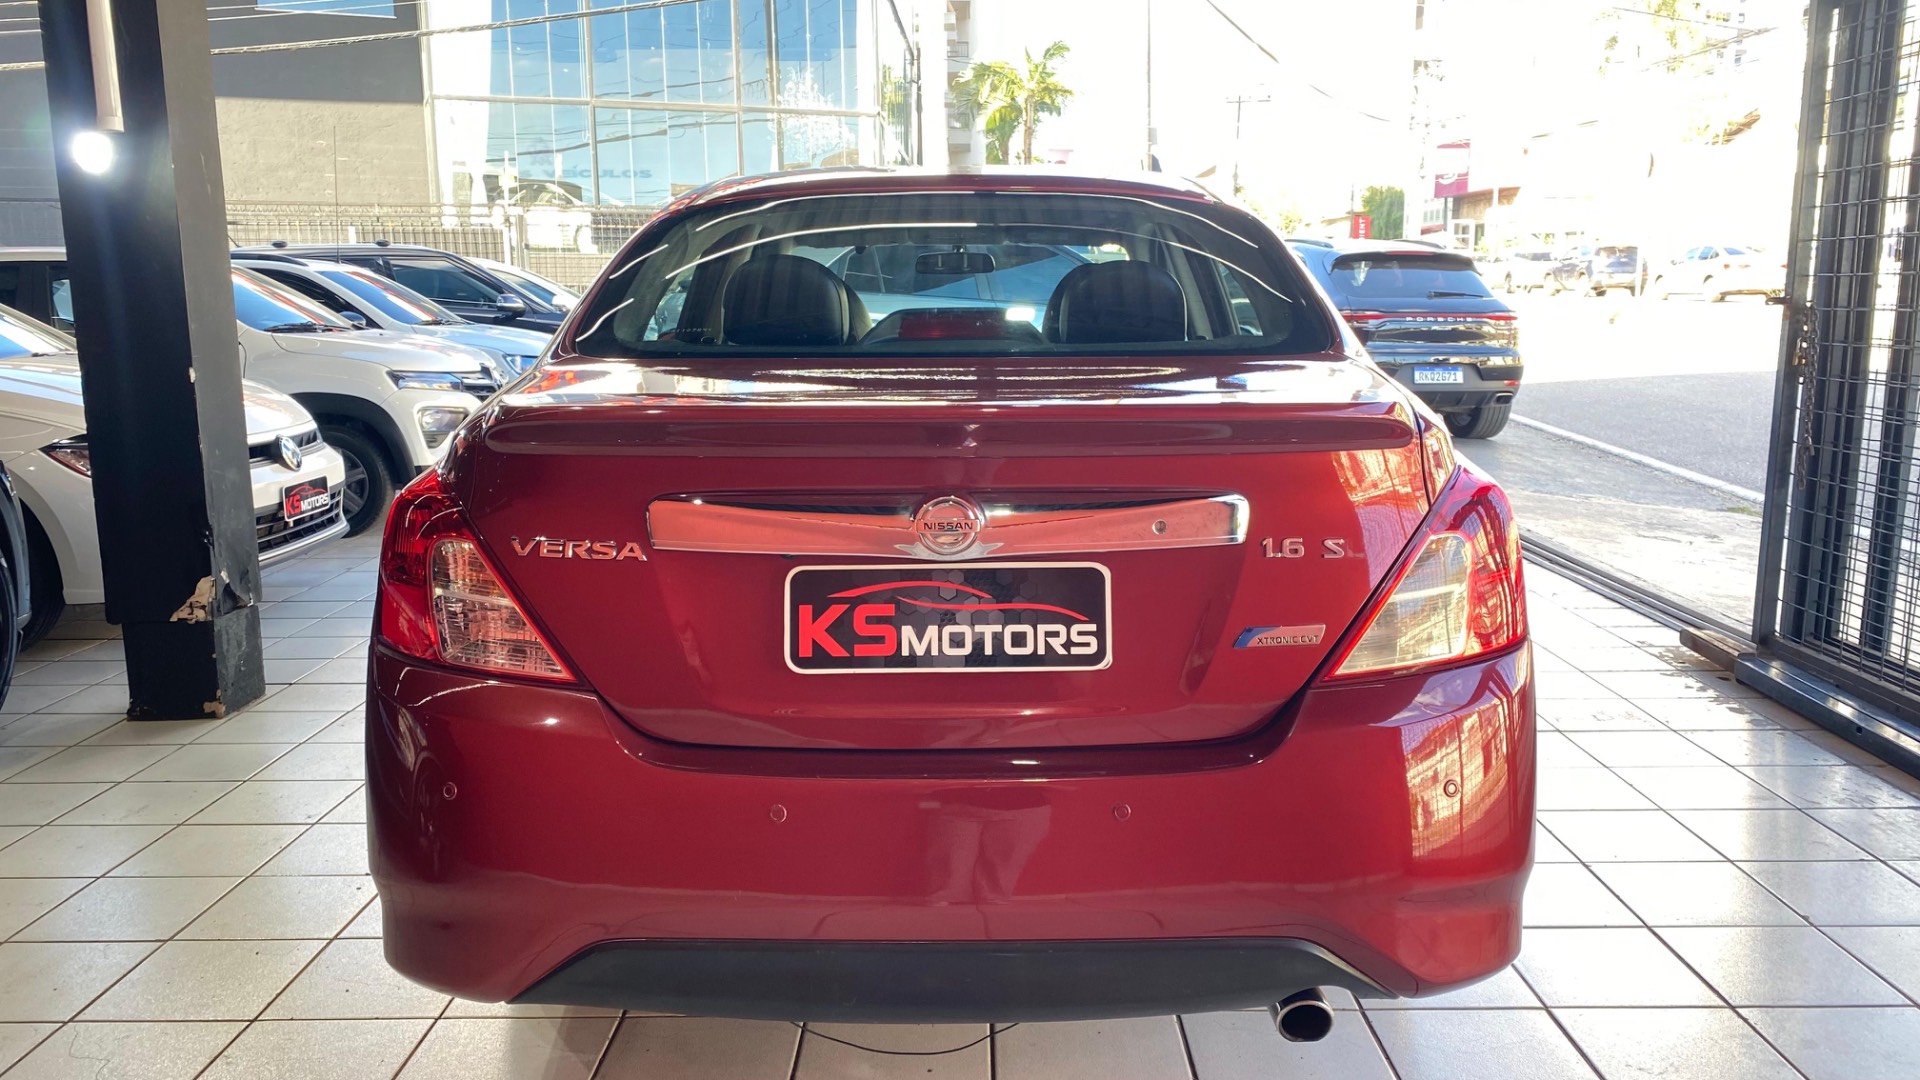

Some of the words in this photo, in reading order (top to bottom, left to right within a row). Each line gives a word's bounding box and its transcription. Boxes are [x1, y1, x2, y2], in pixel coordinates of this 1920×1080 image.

[1418, 371, 1458, 382] RKQ2G71
[286, 494, 302, 516] KS
[301, 493, 329, 512] MOTORS
[922, 521, 974, 531] NISSAN
[511, 536, 648, 562] VERSA
[1262, 537, 1305, 558] 1.6
[1322, 538, 1345, 559] S
[798, 603, 898, 658] KS
[901, 623, 1099, 657] MOTORS
[1256, 635, 1298, 645] XTRONIC
[1300, 634, 1319, 643] CVT
